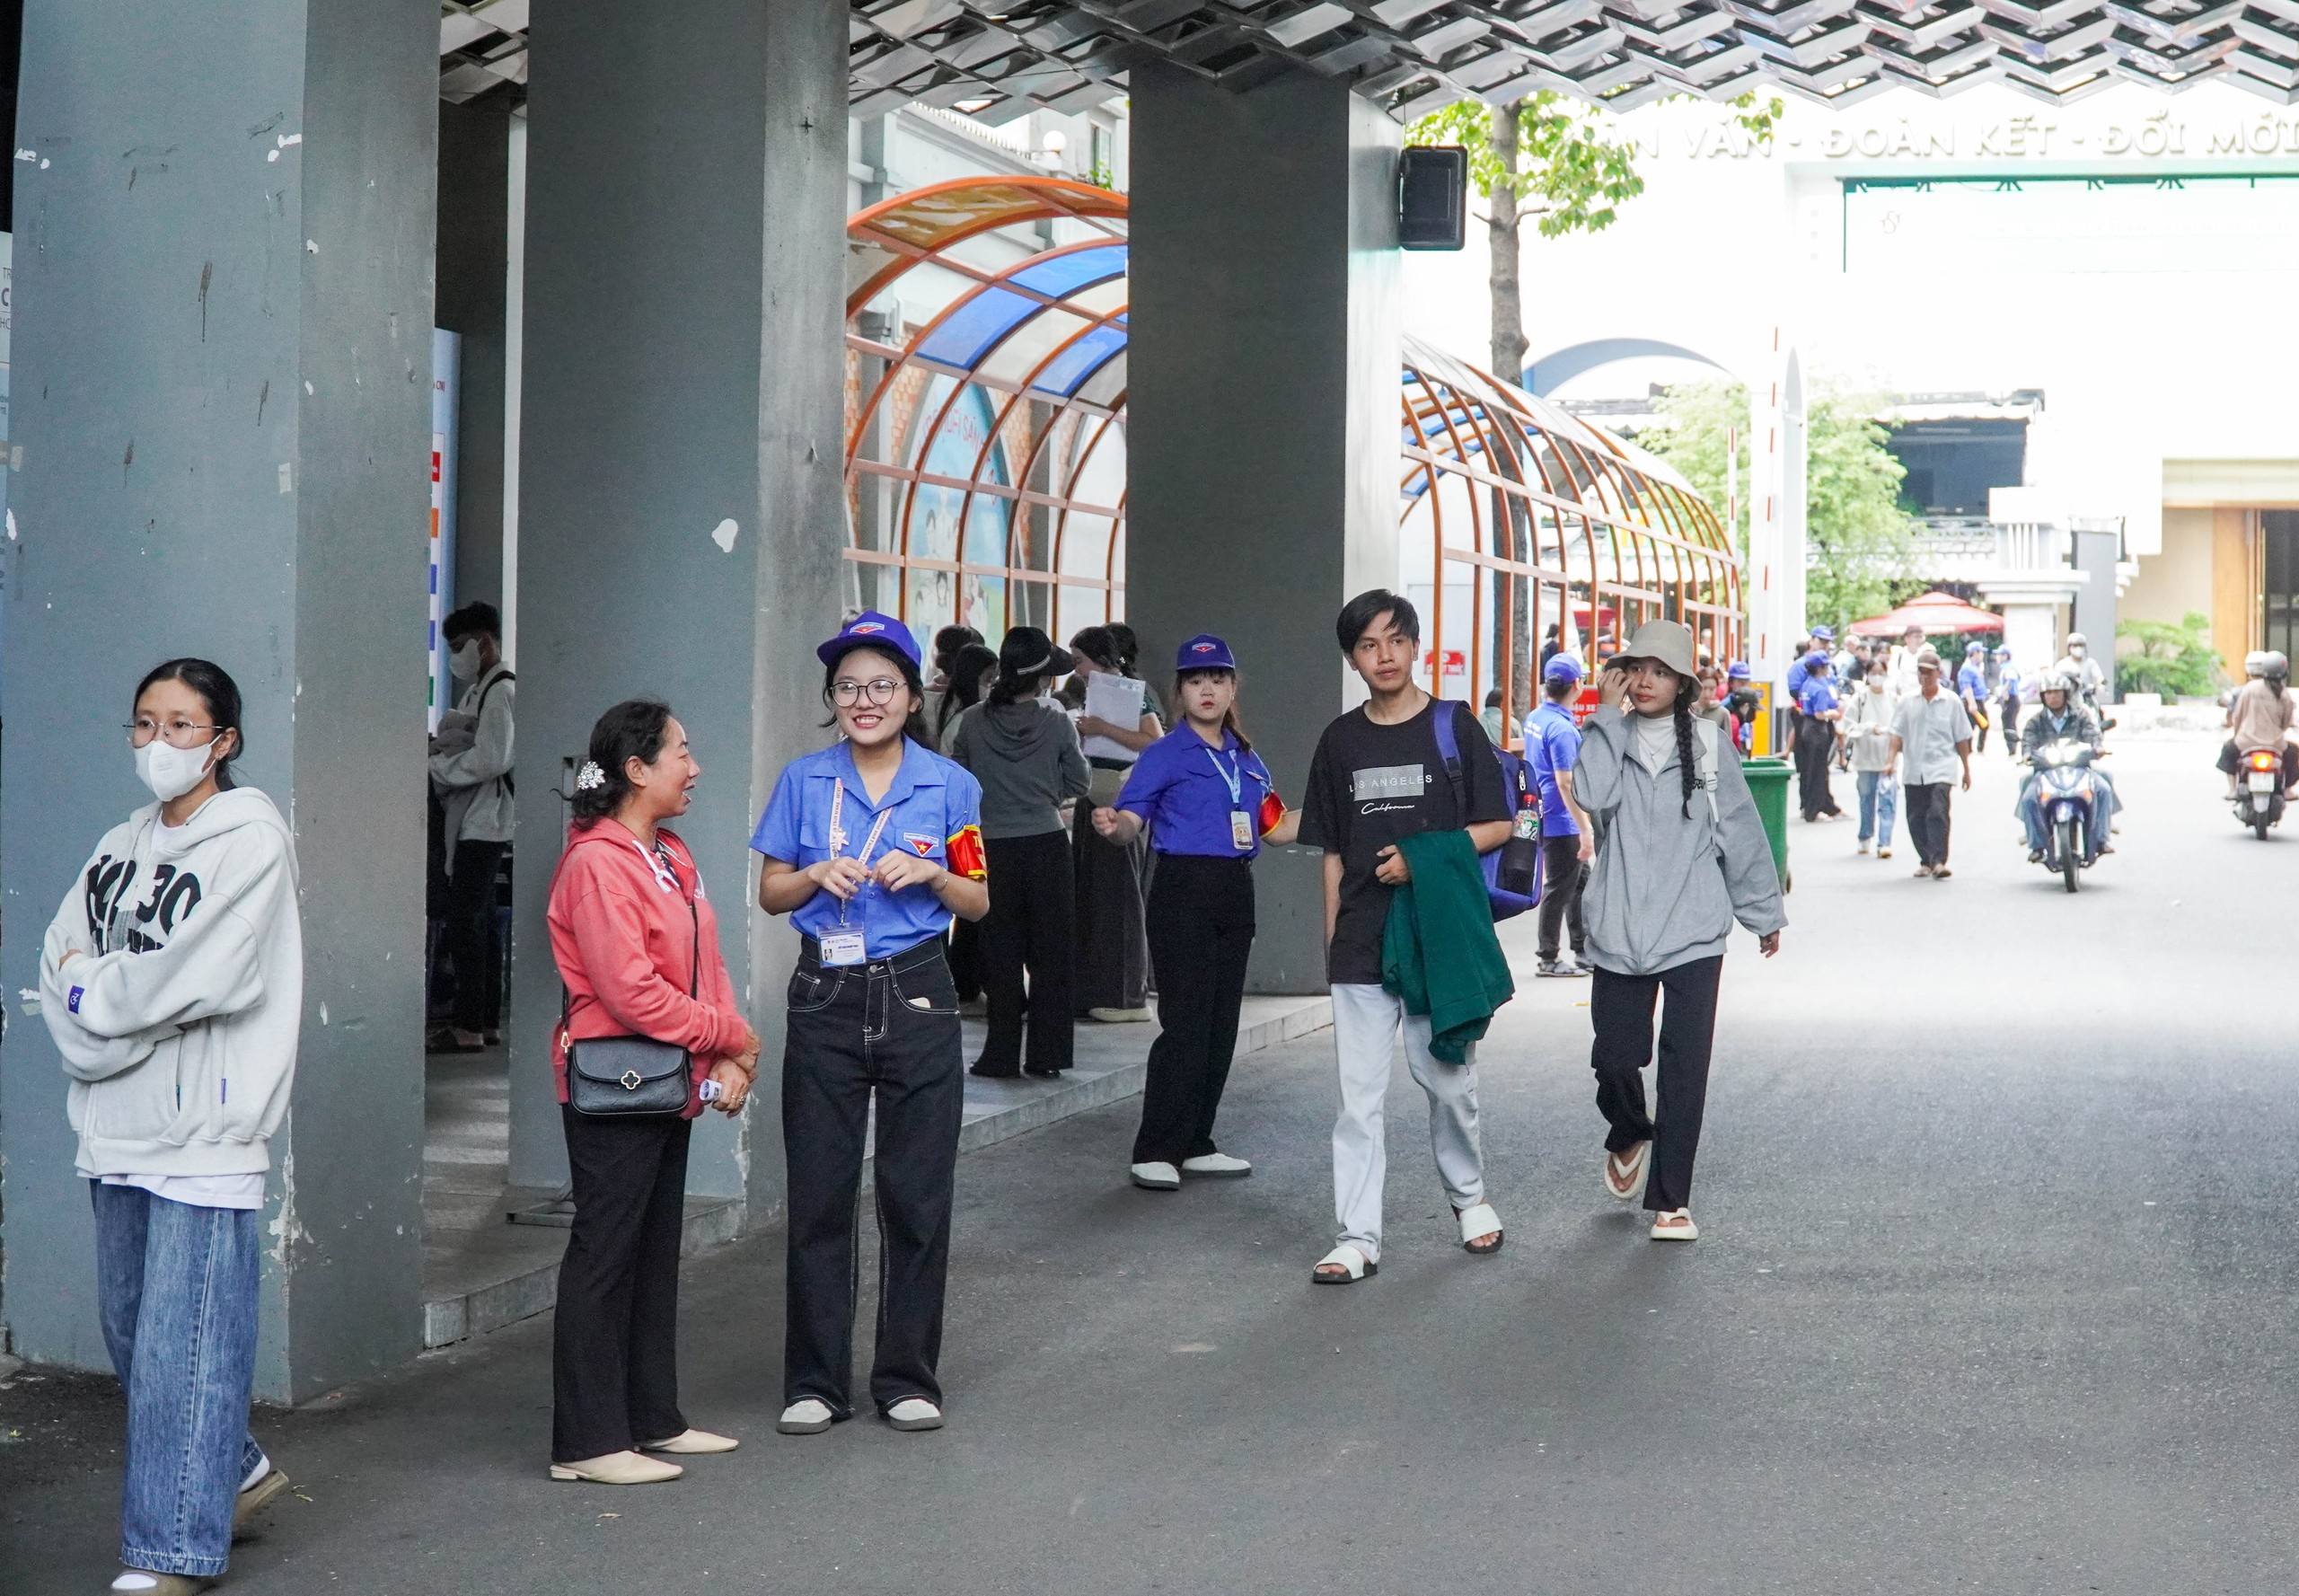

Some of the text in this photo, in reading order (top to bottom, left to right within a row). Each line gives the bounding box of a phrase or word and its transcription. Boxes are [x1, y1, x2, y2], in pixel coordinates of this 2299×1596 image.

[1684, 118, 1771, 158] VĂN
[1975, 114, 2057, 156] KẾT
[1371, 774, 1432, 788] ANGELES
